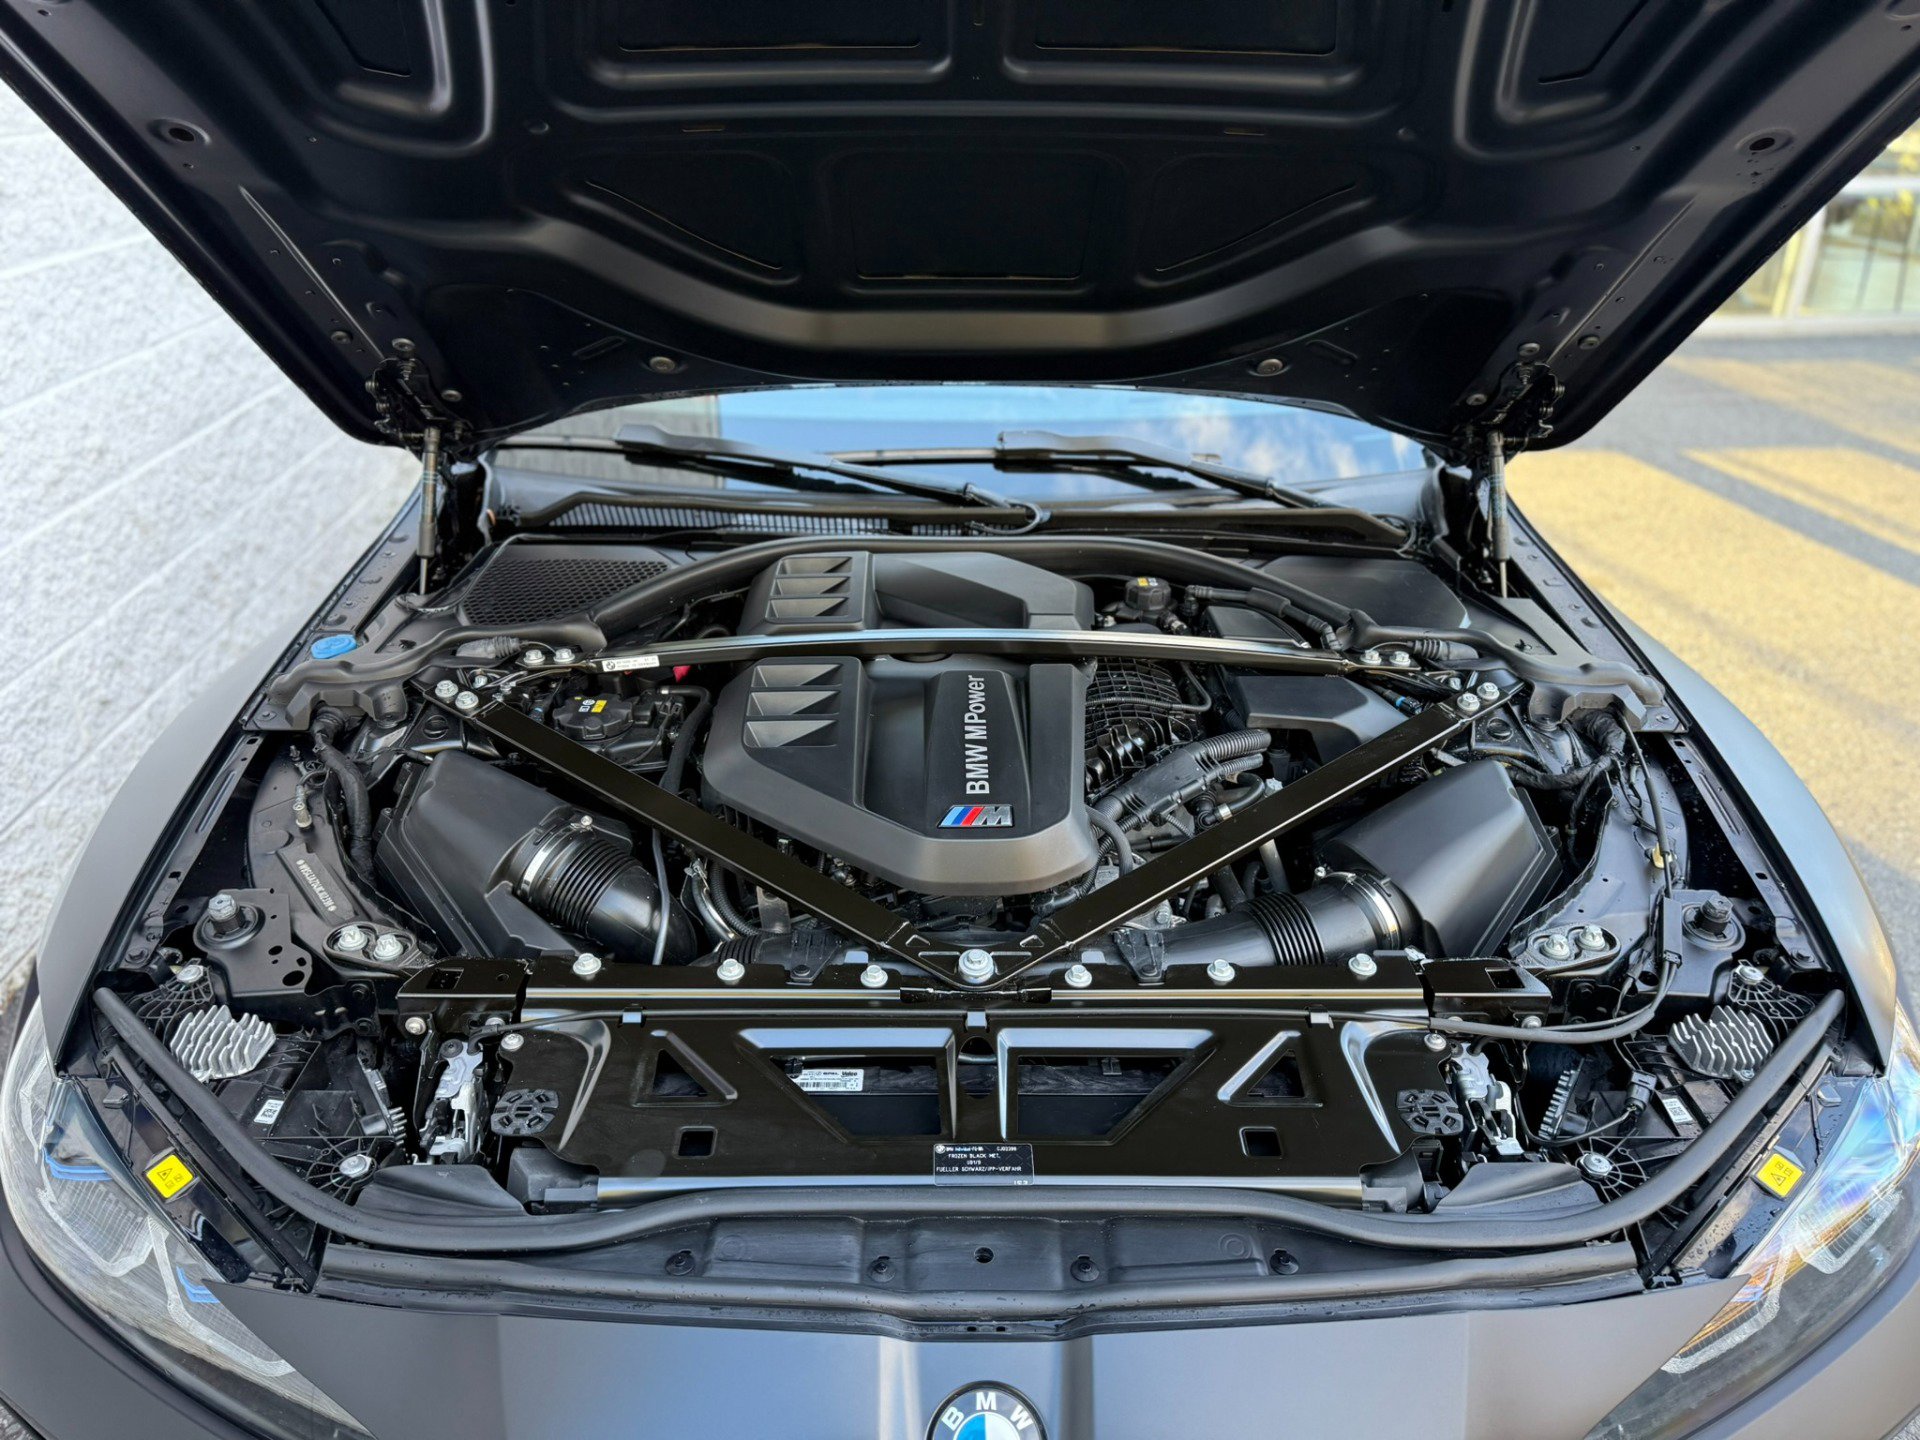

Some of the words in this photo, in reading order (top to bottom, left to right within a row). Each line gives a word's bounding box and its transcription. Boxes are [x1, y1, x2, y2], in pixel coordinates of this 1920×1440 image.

[964, 674, 988, 740] MPower
[964, 744, 990, 794] BMW
[941, 1391, 1034, 1432] BMW
